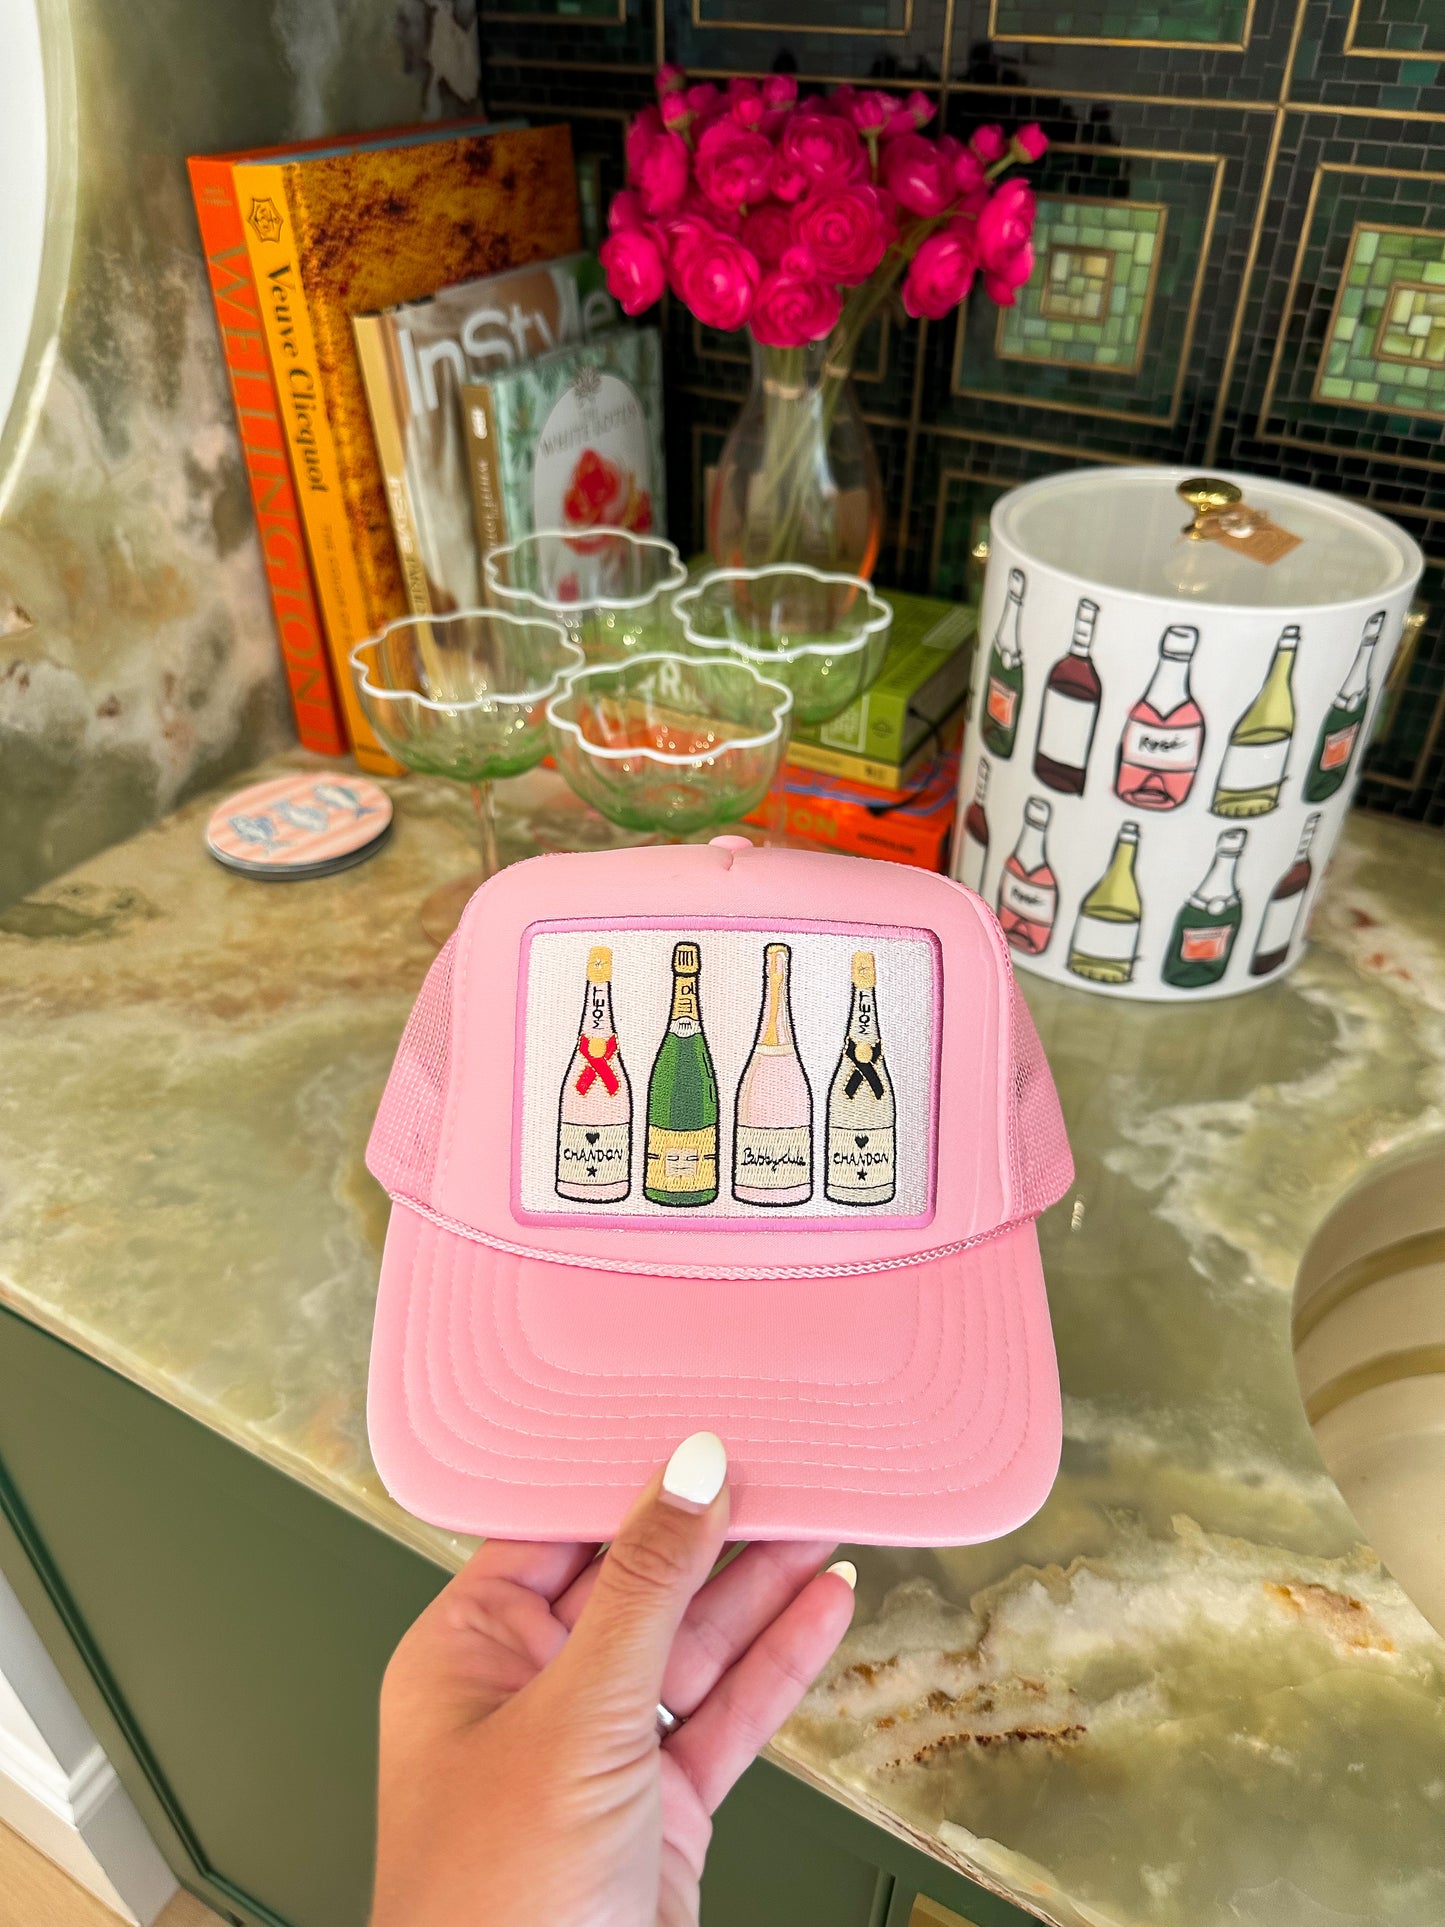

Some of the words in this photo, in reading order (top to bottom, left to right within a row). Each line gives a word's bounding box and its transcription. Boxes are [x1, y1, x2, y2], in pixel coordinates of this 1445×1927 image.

[268, 264, 299, 358] Veuve
[289, 366, 329, 493] Clicquot
[207, 244, 332, 709] WELLINGTON
[592, 985, 605, 1030] MOET
[858, 990, 871, 1035] MOET
[563, 1147, 623, 1162] CHANDON
[833, 1152, 889, 1166] CHANDON
